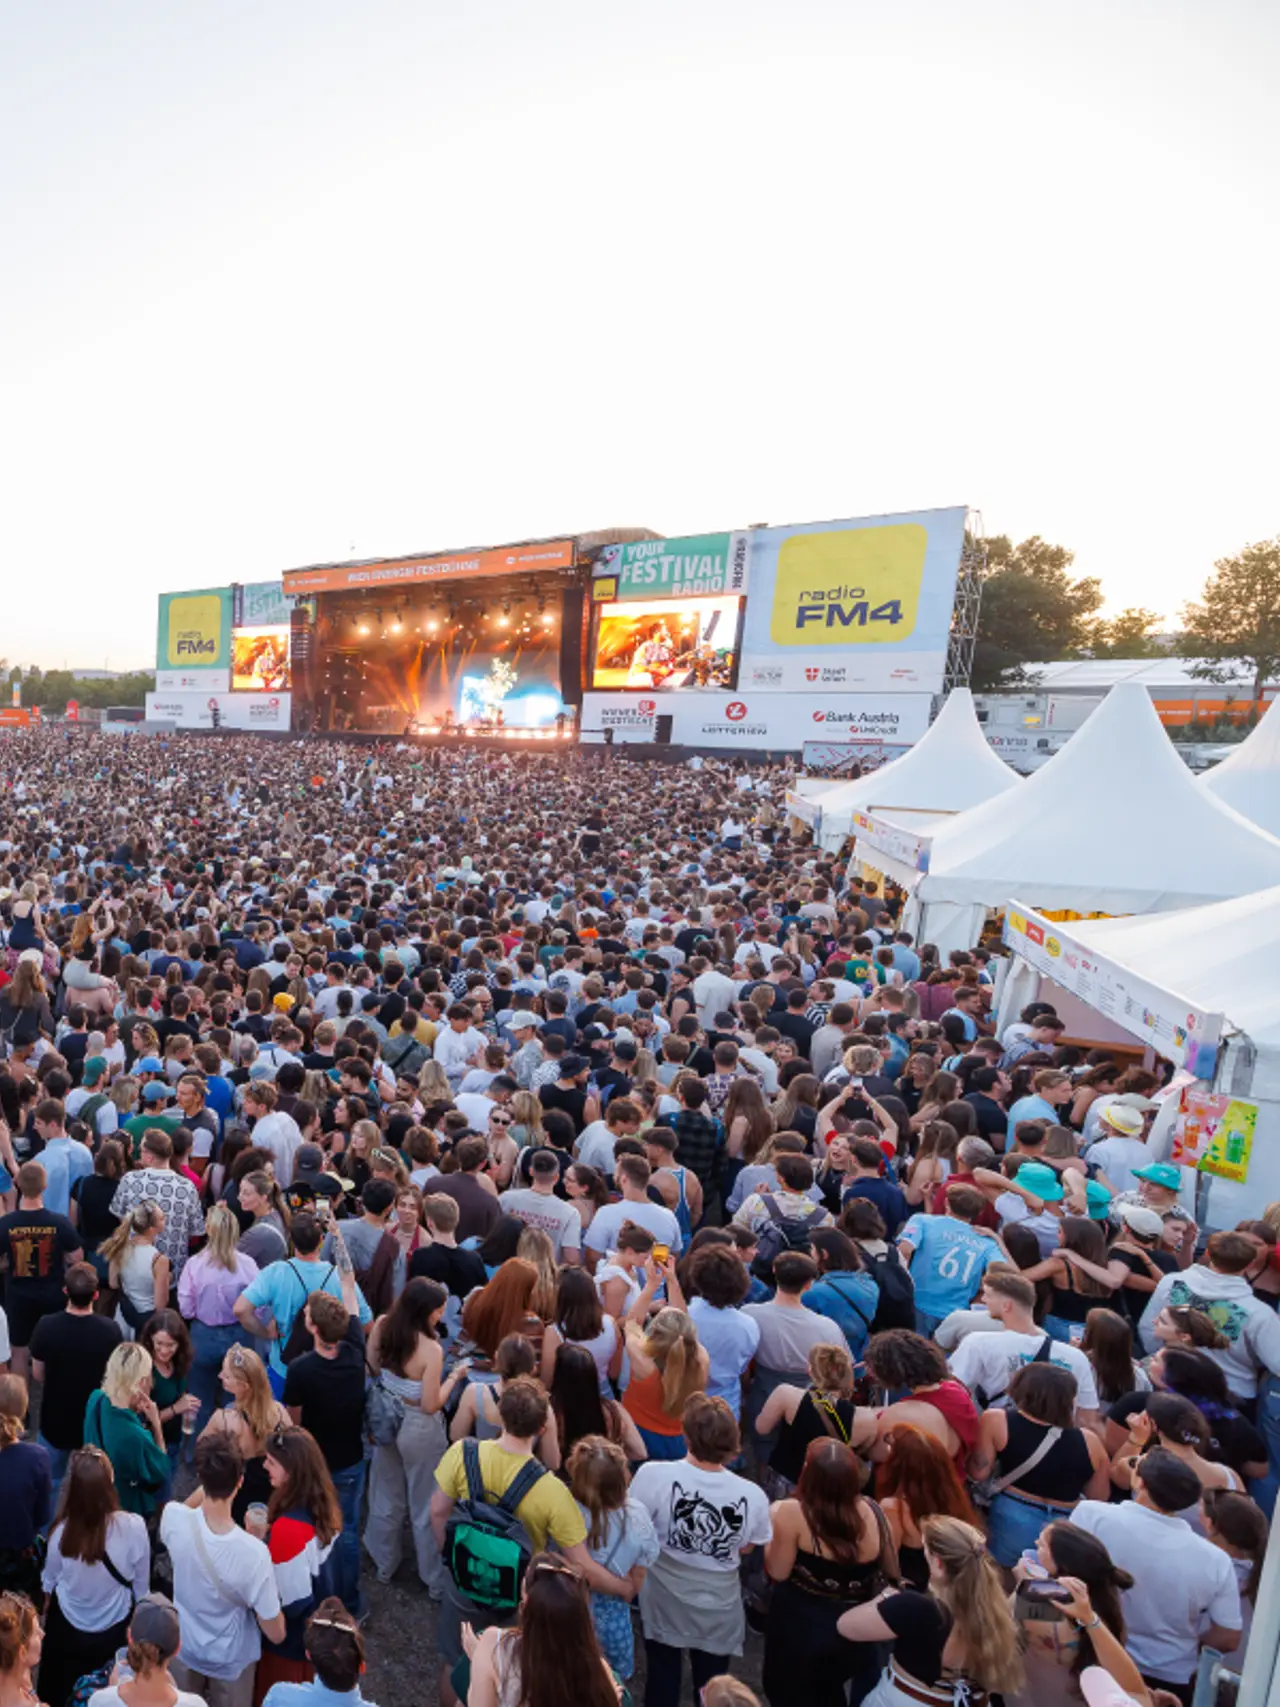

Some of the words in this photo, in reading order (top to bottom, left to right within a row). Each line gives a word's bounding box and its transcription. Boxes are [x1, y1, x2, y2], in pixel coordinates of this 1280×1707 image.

[627, 542, 666, 562] YOUR
[620, 554, 724, 584] FESTIVAL
[672, 576, 722, 597] RADIO
[799, 585, 866, 603] radio
[796, 600, 904, 629] FM4
[177, 640, 215, 655] FM4
[826, 712, 856, 723] Bank
[858, 712, 899, 724] Austria
[702, 727, 767, 735] LOTTERIEN
[939, 1246, 976, 1285] 61
